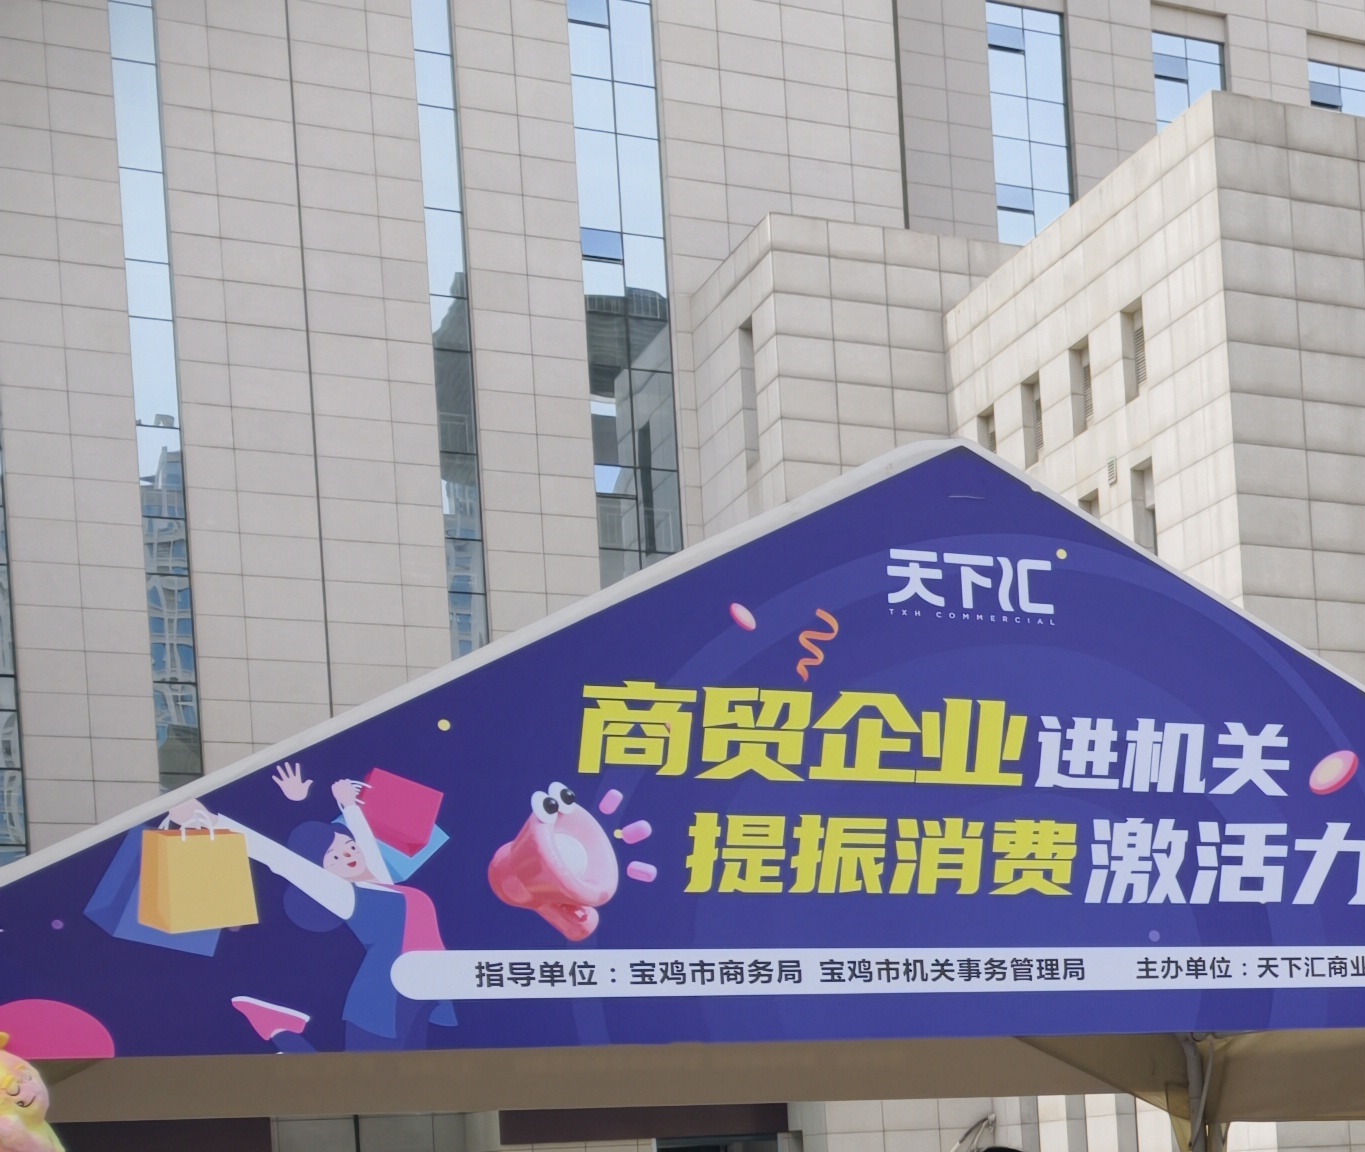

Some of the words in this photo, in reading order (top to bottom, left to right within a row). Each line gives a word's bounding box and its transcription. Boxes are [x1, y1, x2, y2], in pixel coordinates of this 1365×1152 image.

[886, 548, 1055, 614] 天下汇
[888, 608, 921, 617] TXH
[935, 611, 1056, 626] COMMERCIAL
[578, 681, 1290, 797] 商贸企业进机关
[819, 957, 1085, 984] 宝鸡市机关事务管理局
